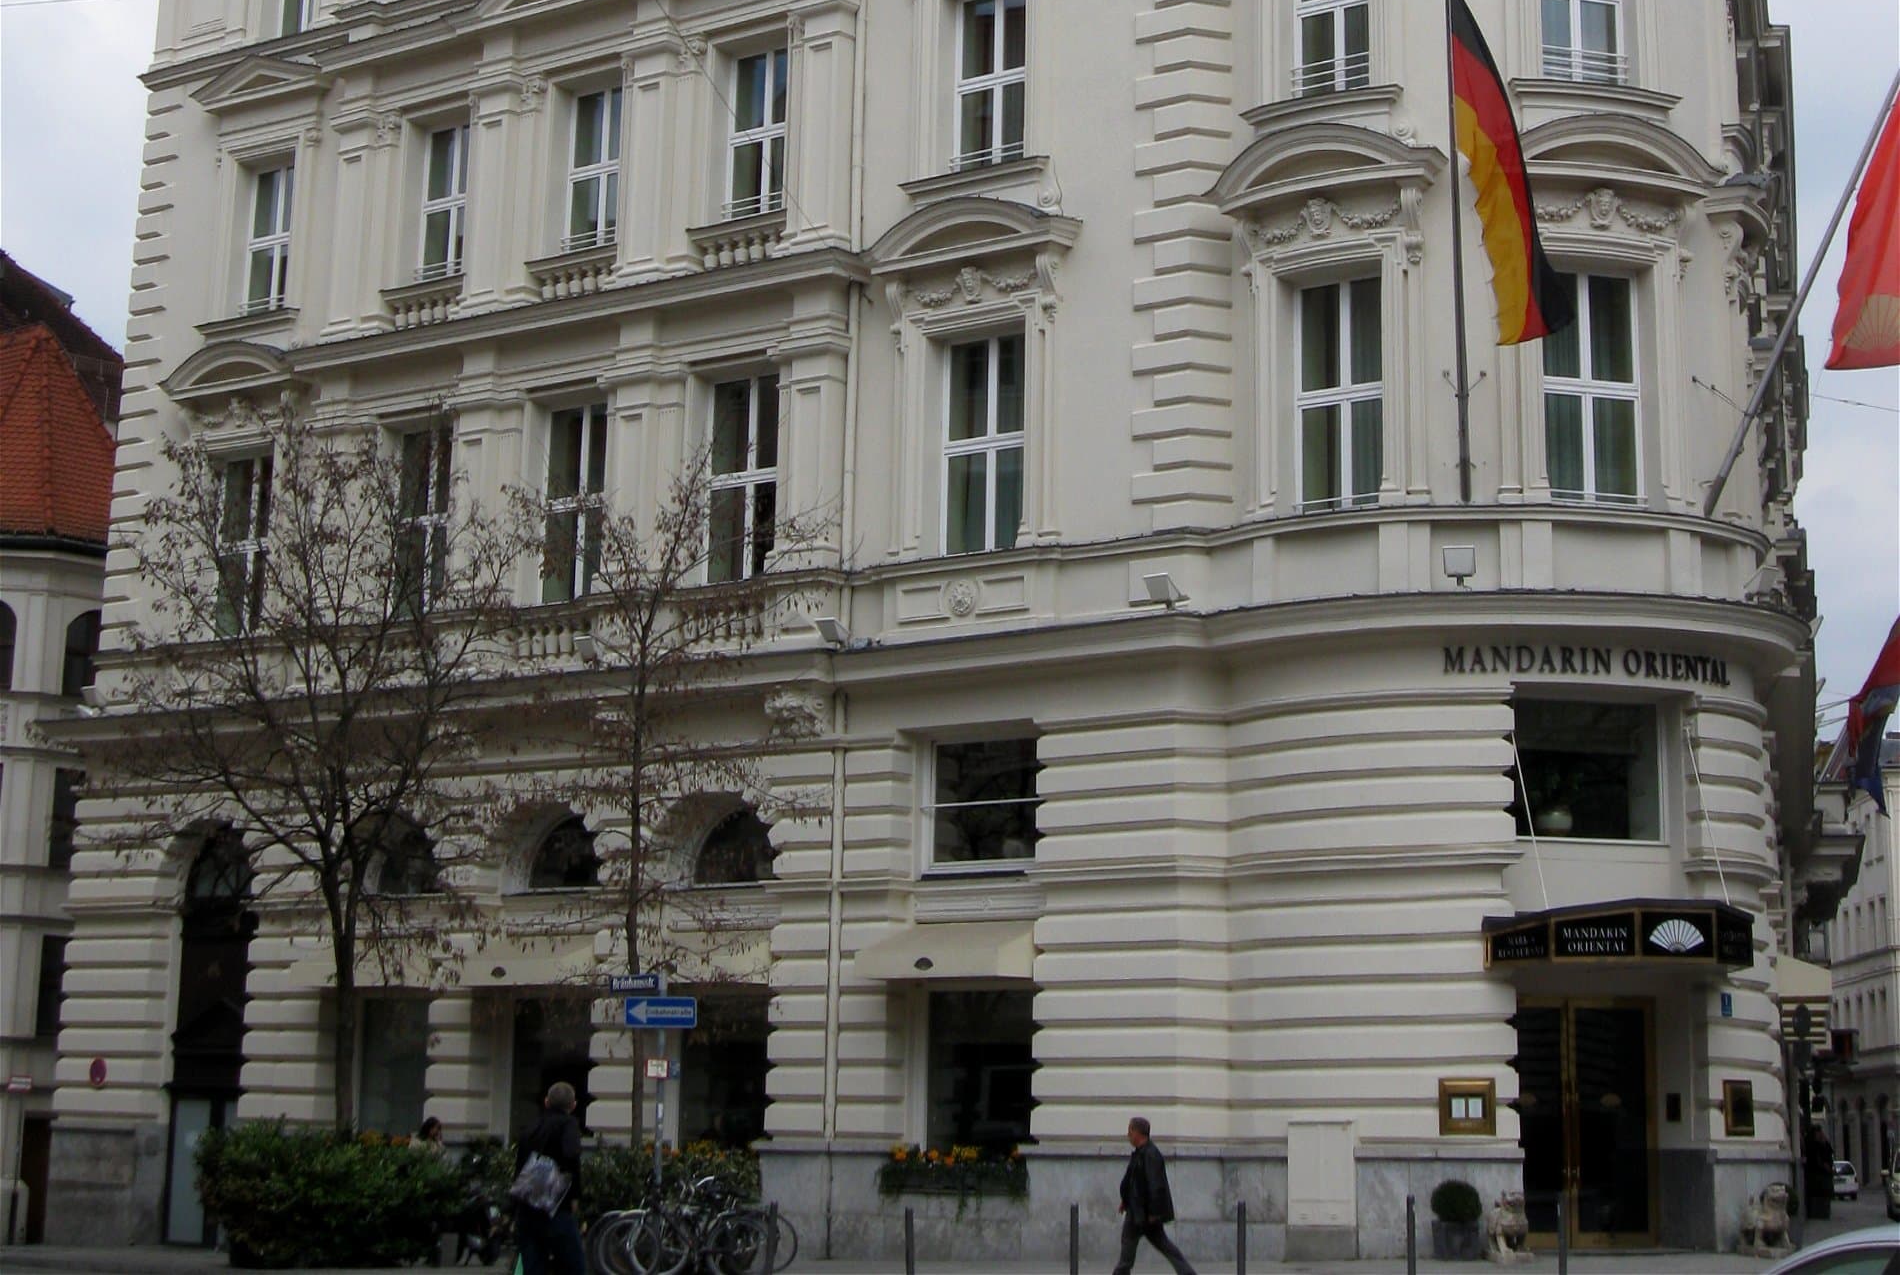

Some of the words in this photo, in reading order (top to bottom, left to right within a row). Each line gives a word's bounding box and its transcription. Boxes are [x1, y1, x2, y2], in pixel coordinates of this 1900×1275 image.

[1443, 645, 1611, 676] MANDARIN
[1623, 649, 1730, 687] ORIENTAL
[1563, 927, 1628, 939] MANDARIN
[1567, 940, 1626, 953] ORIENTAL
